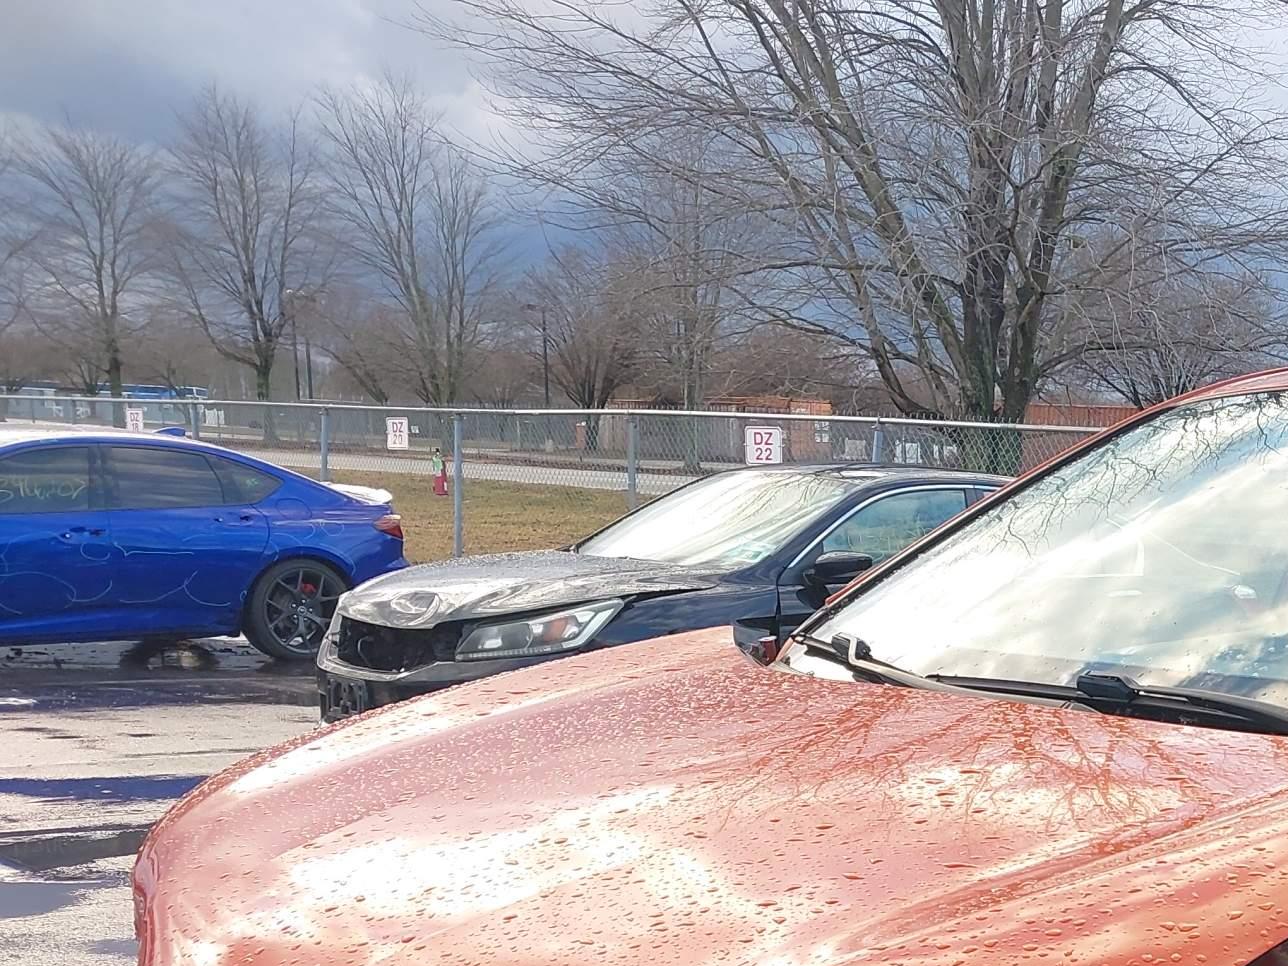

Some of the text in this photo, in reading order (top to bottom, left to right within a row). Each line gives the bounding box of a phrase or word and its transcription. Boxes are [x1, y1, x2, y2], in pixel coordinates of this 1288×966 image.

[391, 421, 404, 433] DZ
[753, 431, 774, 446] DZ
[755, 447, 773, 461] 22
